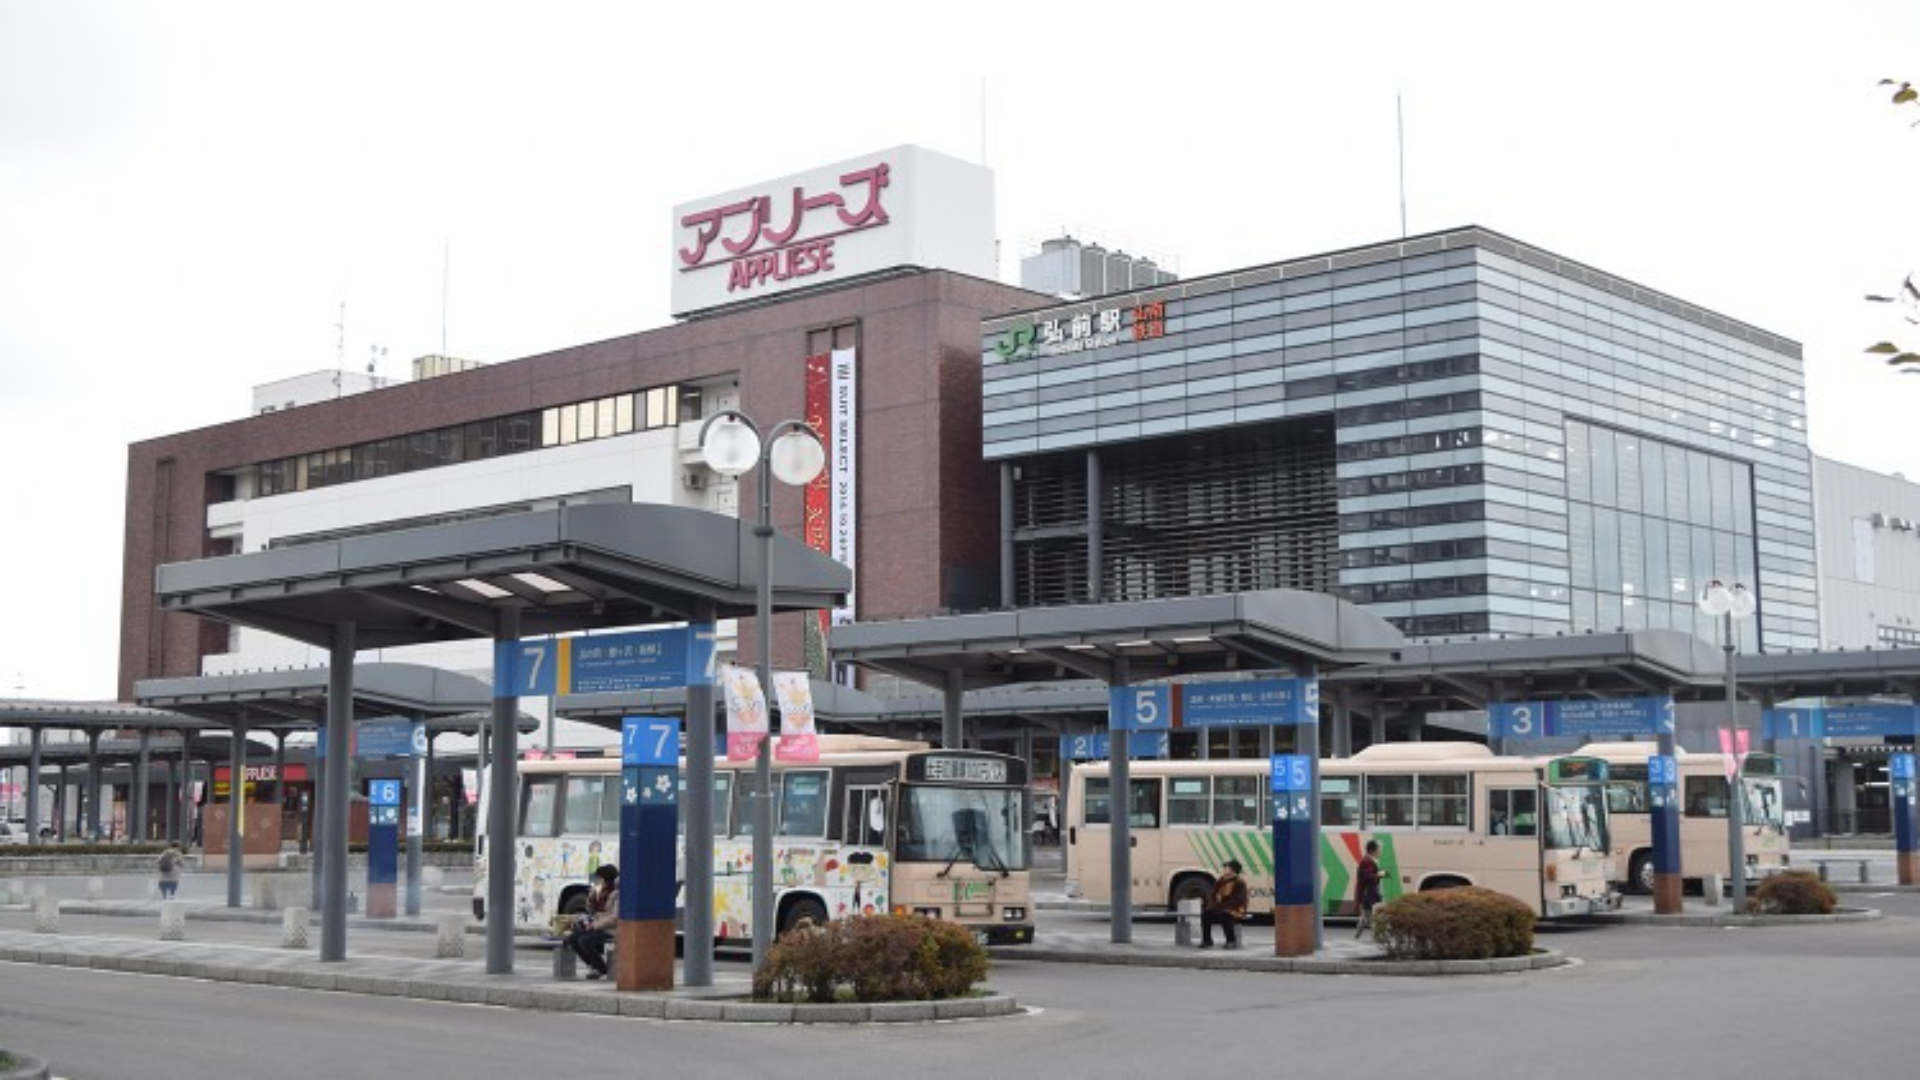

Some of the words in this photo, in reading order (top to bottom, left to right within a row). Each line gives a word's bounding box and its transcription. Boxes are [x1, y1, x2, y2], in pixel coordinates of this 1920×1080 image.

[679, 163, 889, 265] アプリーズ
[727, 240, 835, 292] APPLIESE
[994, 324, 1037, 357] JR
[1043, 308, 1120, 345] 弘前駅
[524, 647, 545, 690] 7
[1135, 691, 1158, 723] 5
[1511, 706, 1532, 734] 3
[1788, 712, 1798, 735] 1
[625, 724, 638, 745] 7
[649, 724, 671, 759] 7
[1074, 736, 1086, 755] 2
[1274, 760, 1286, 777] 5
[1292, 760, 1307, 786] 5
[383, 782, 396, 803] 6
